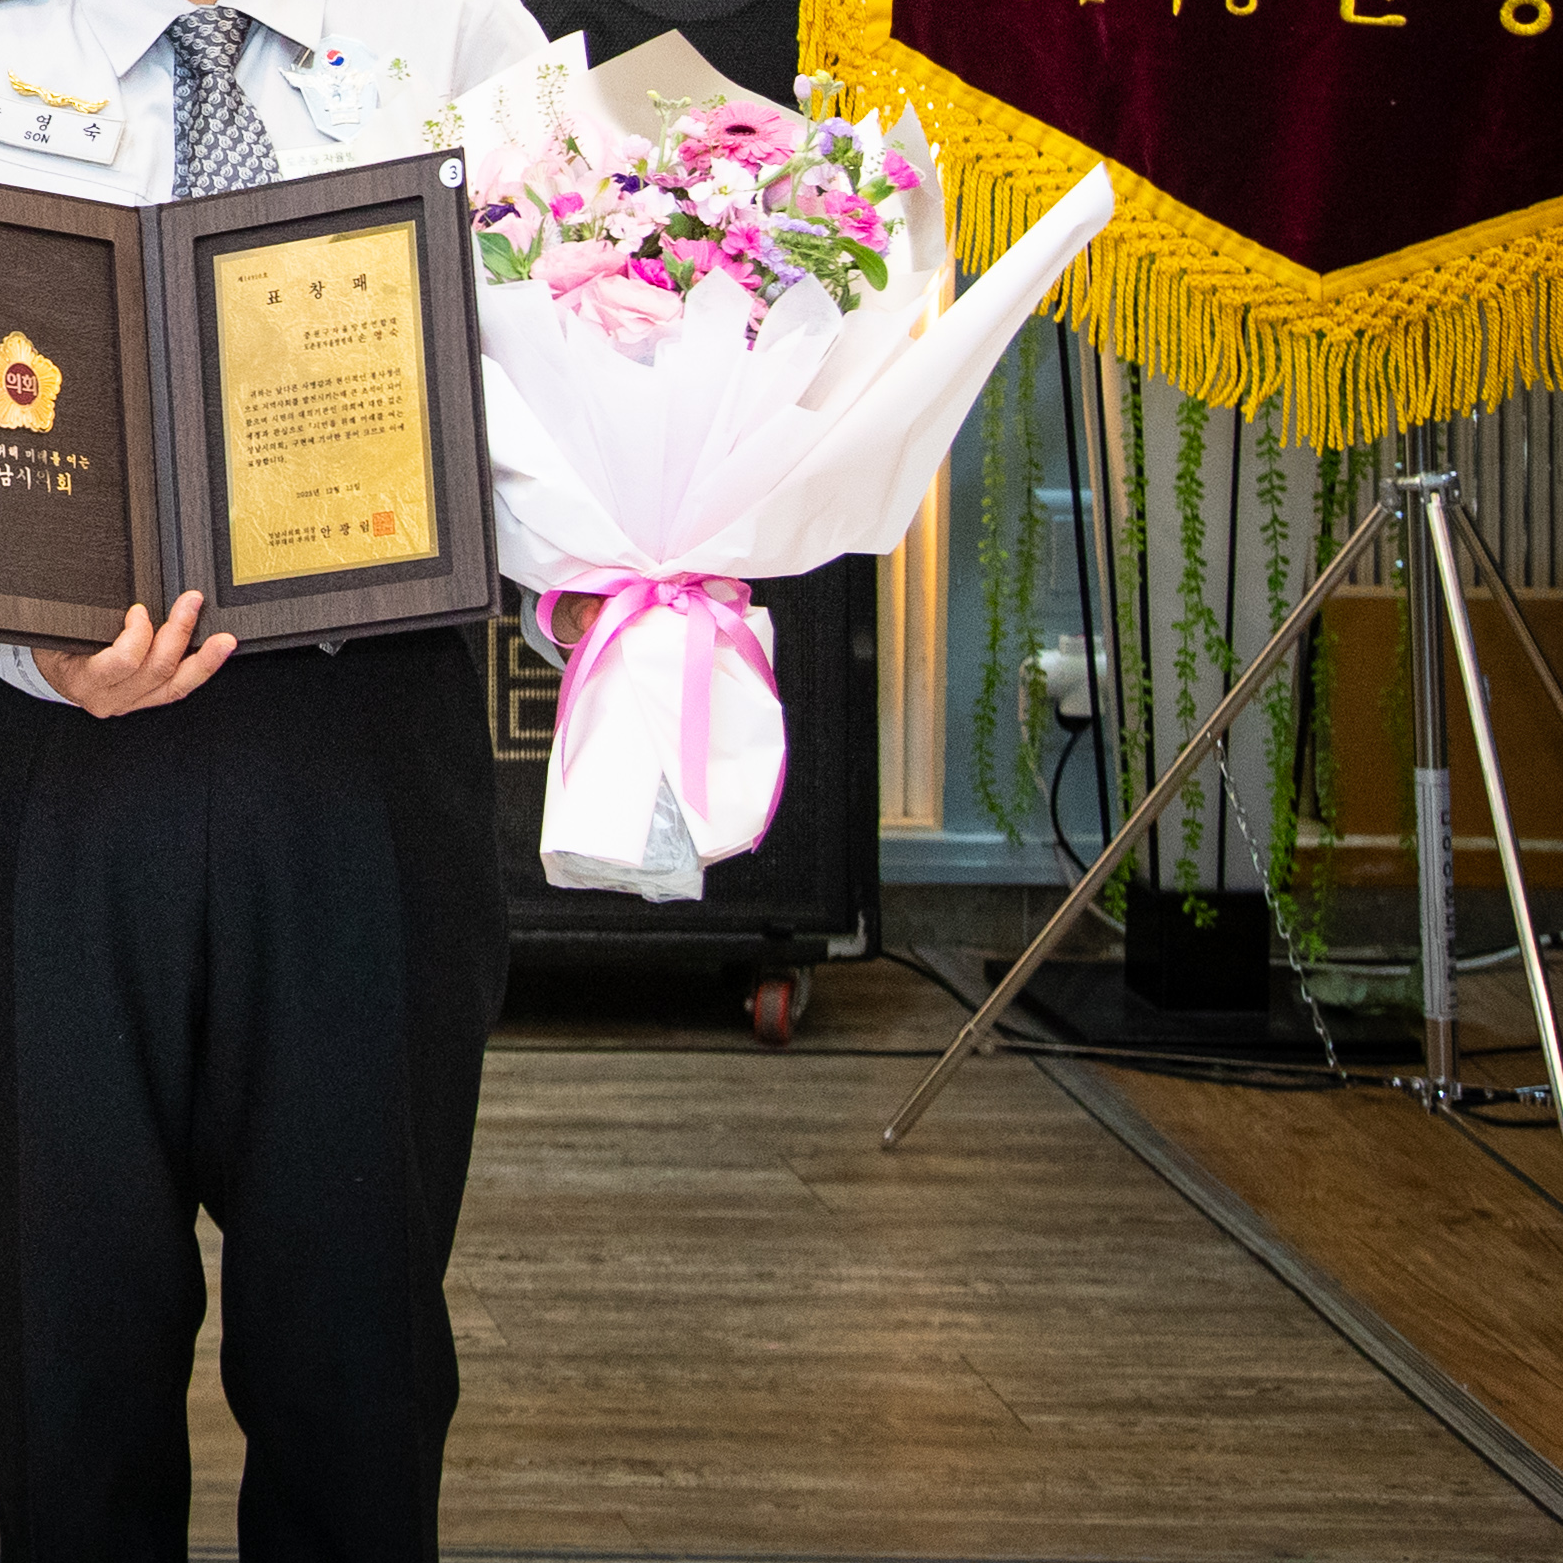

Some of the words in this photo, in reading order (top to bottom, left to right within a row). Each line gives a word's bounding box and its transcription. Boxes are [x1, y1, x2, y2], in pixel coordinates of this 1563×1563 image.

[24, 131, 51, 145] SON
[449, 165, 458, 180] 3
[6, 373, 37, 396] 의회
[25, 448, 61, 466] 미래를
[67, 454, 90, 469] 여는
